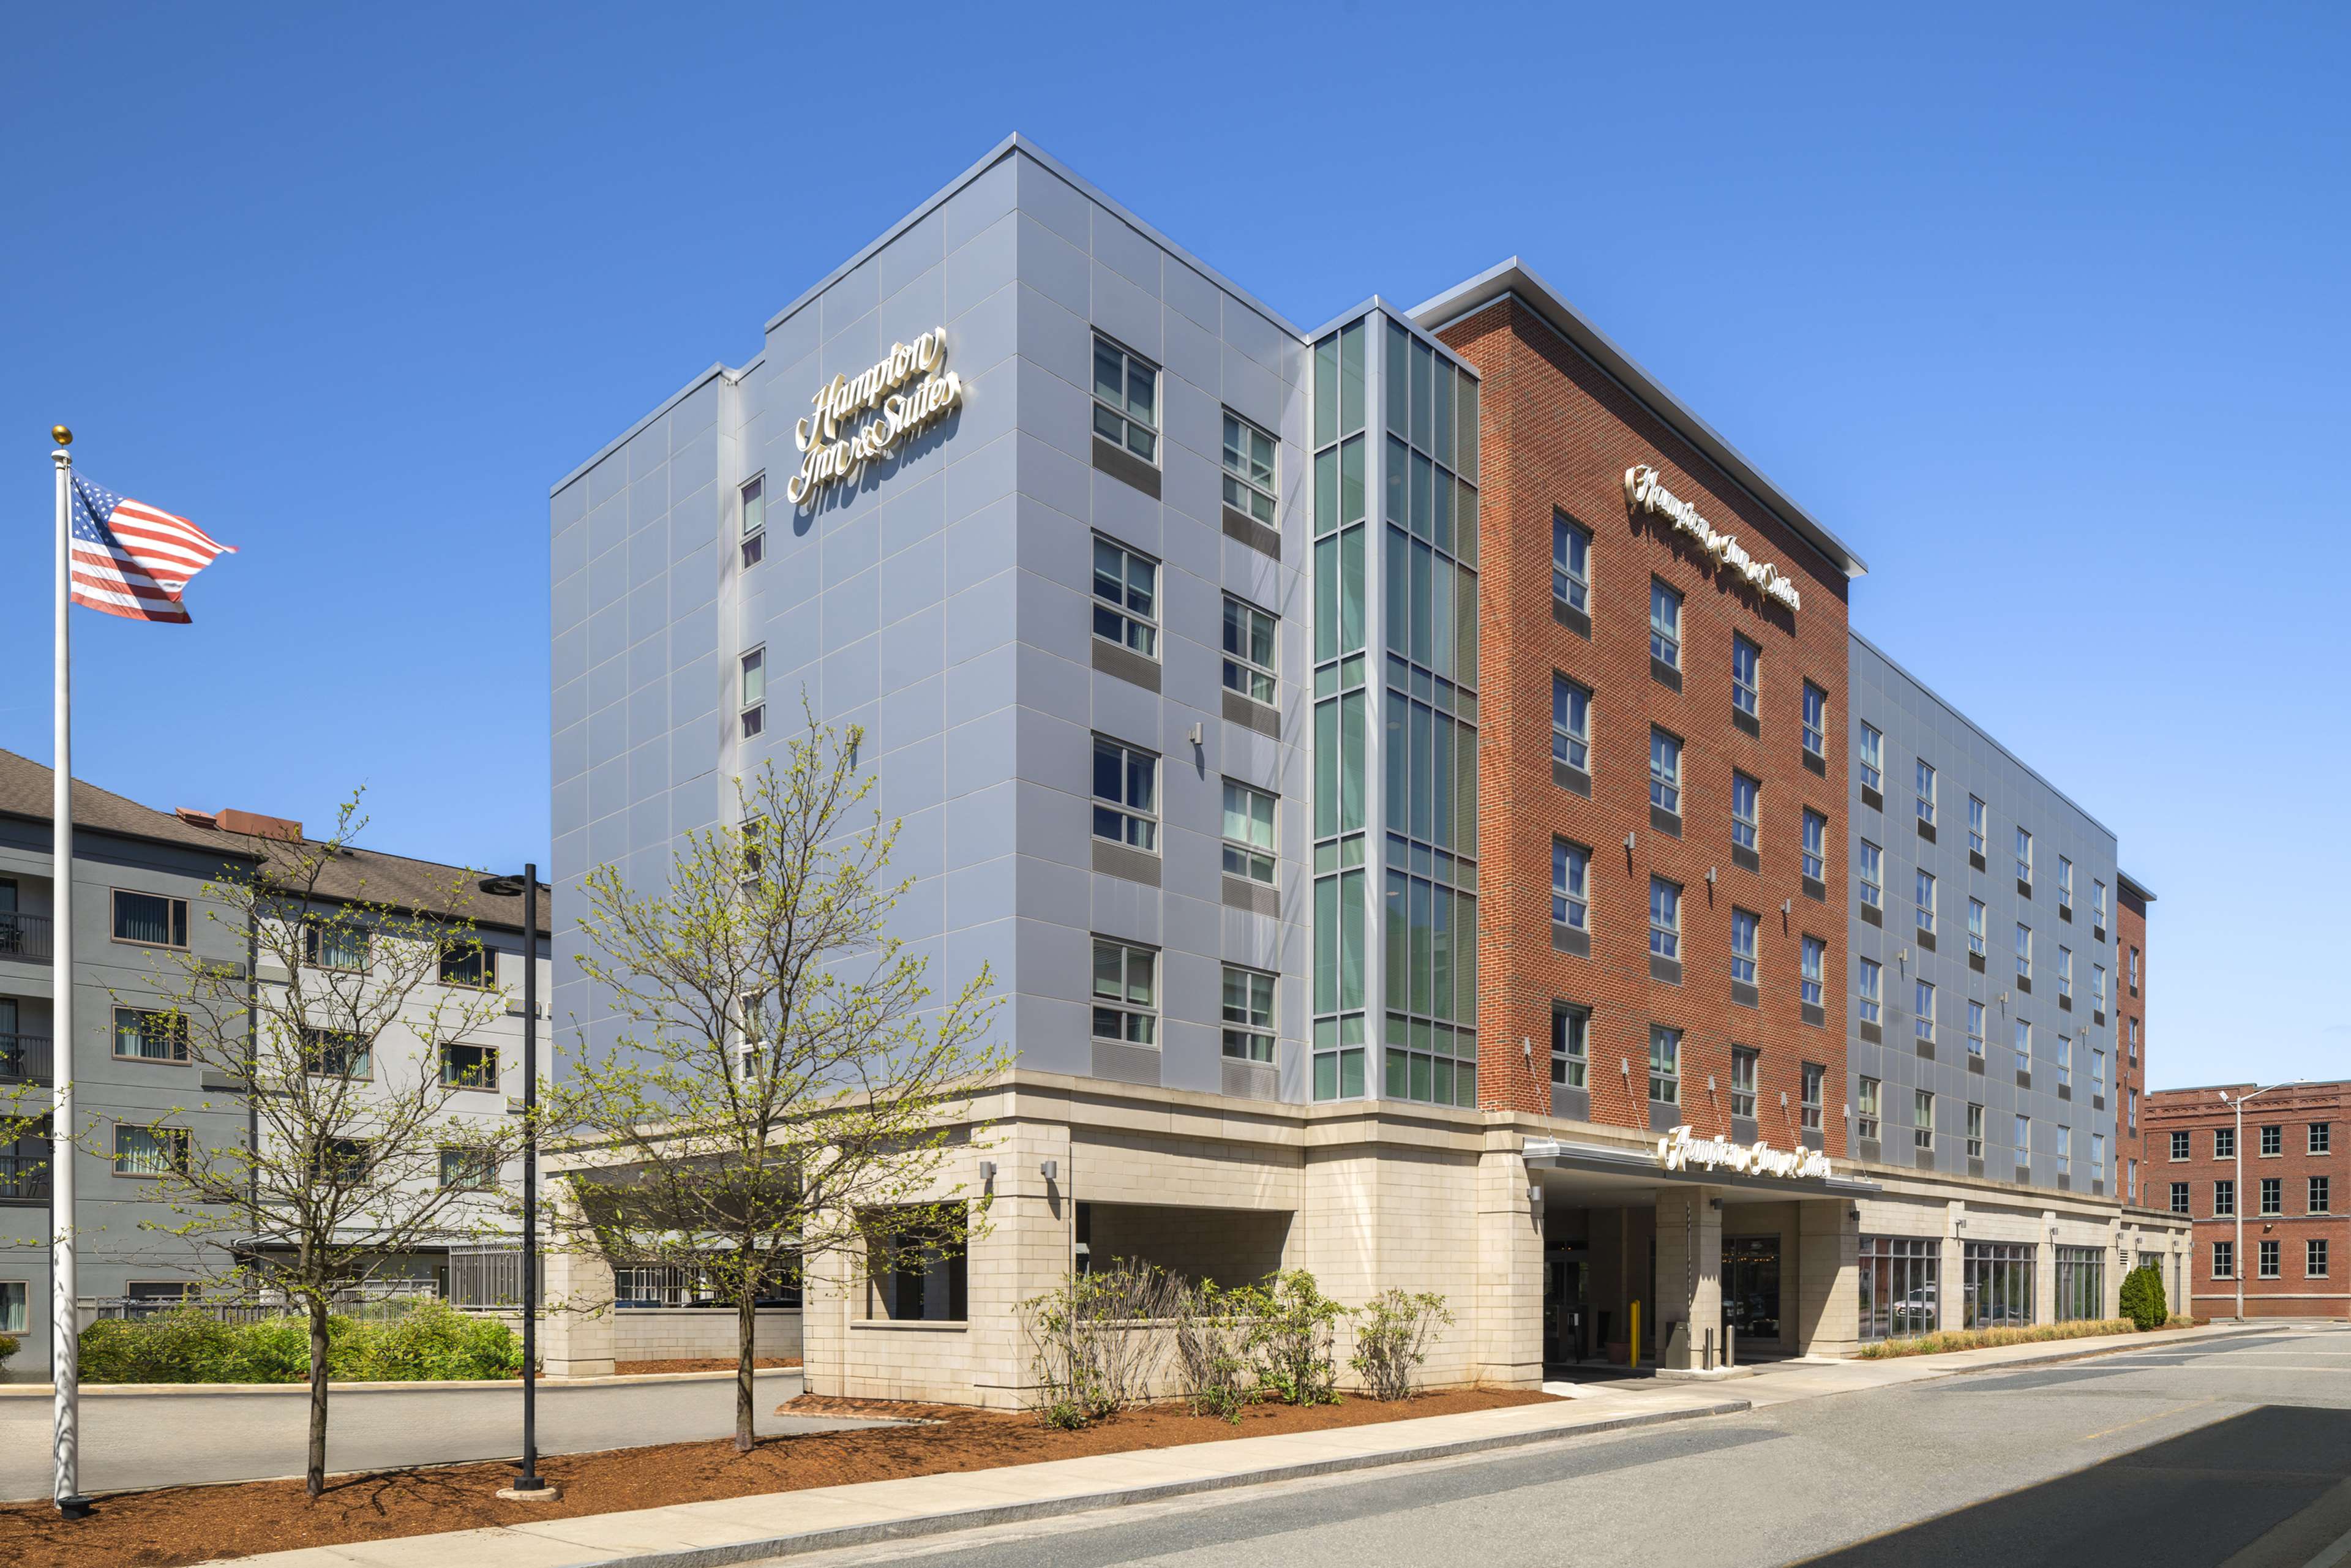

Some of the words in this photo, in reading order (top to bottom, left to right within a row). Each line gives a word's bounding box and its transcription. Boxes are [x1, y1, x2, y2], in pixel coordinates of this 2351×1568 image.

[787, 436, 861, 505] Inn
[855, 425, 881, 460] &
[872, 370, 961, 448] Suites
[795, 326, 947, 452] Hampton
[1625, 464, 1716, 550] Hampton
[1714, 535, 1756, 580] Inn
[1763, 563, 1800, 611] Suites
[1657, 1125, 1747, 1172] Hampton
[1794, 1146, 1832, 1179] Suites
